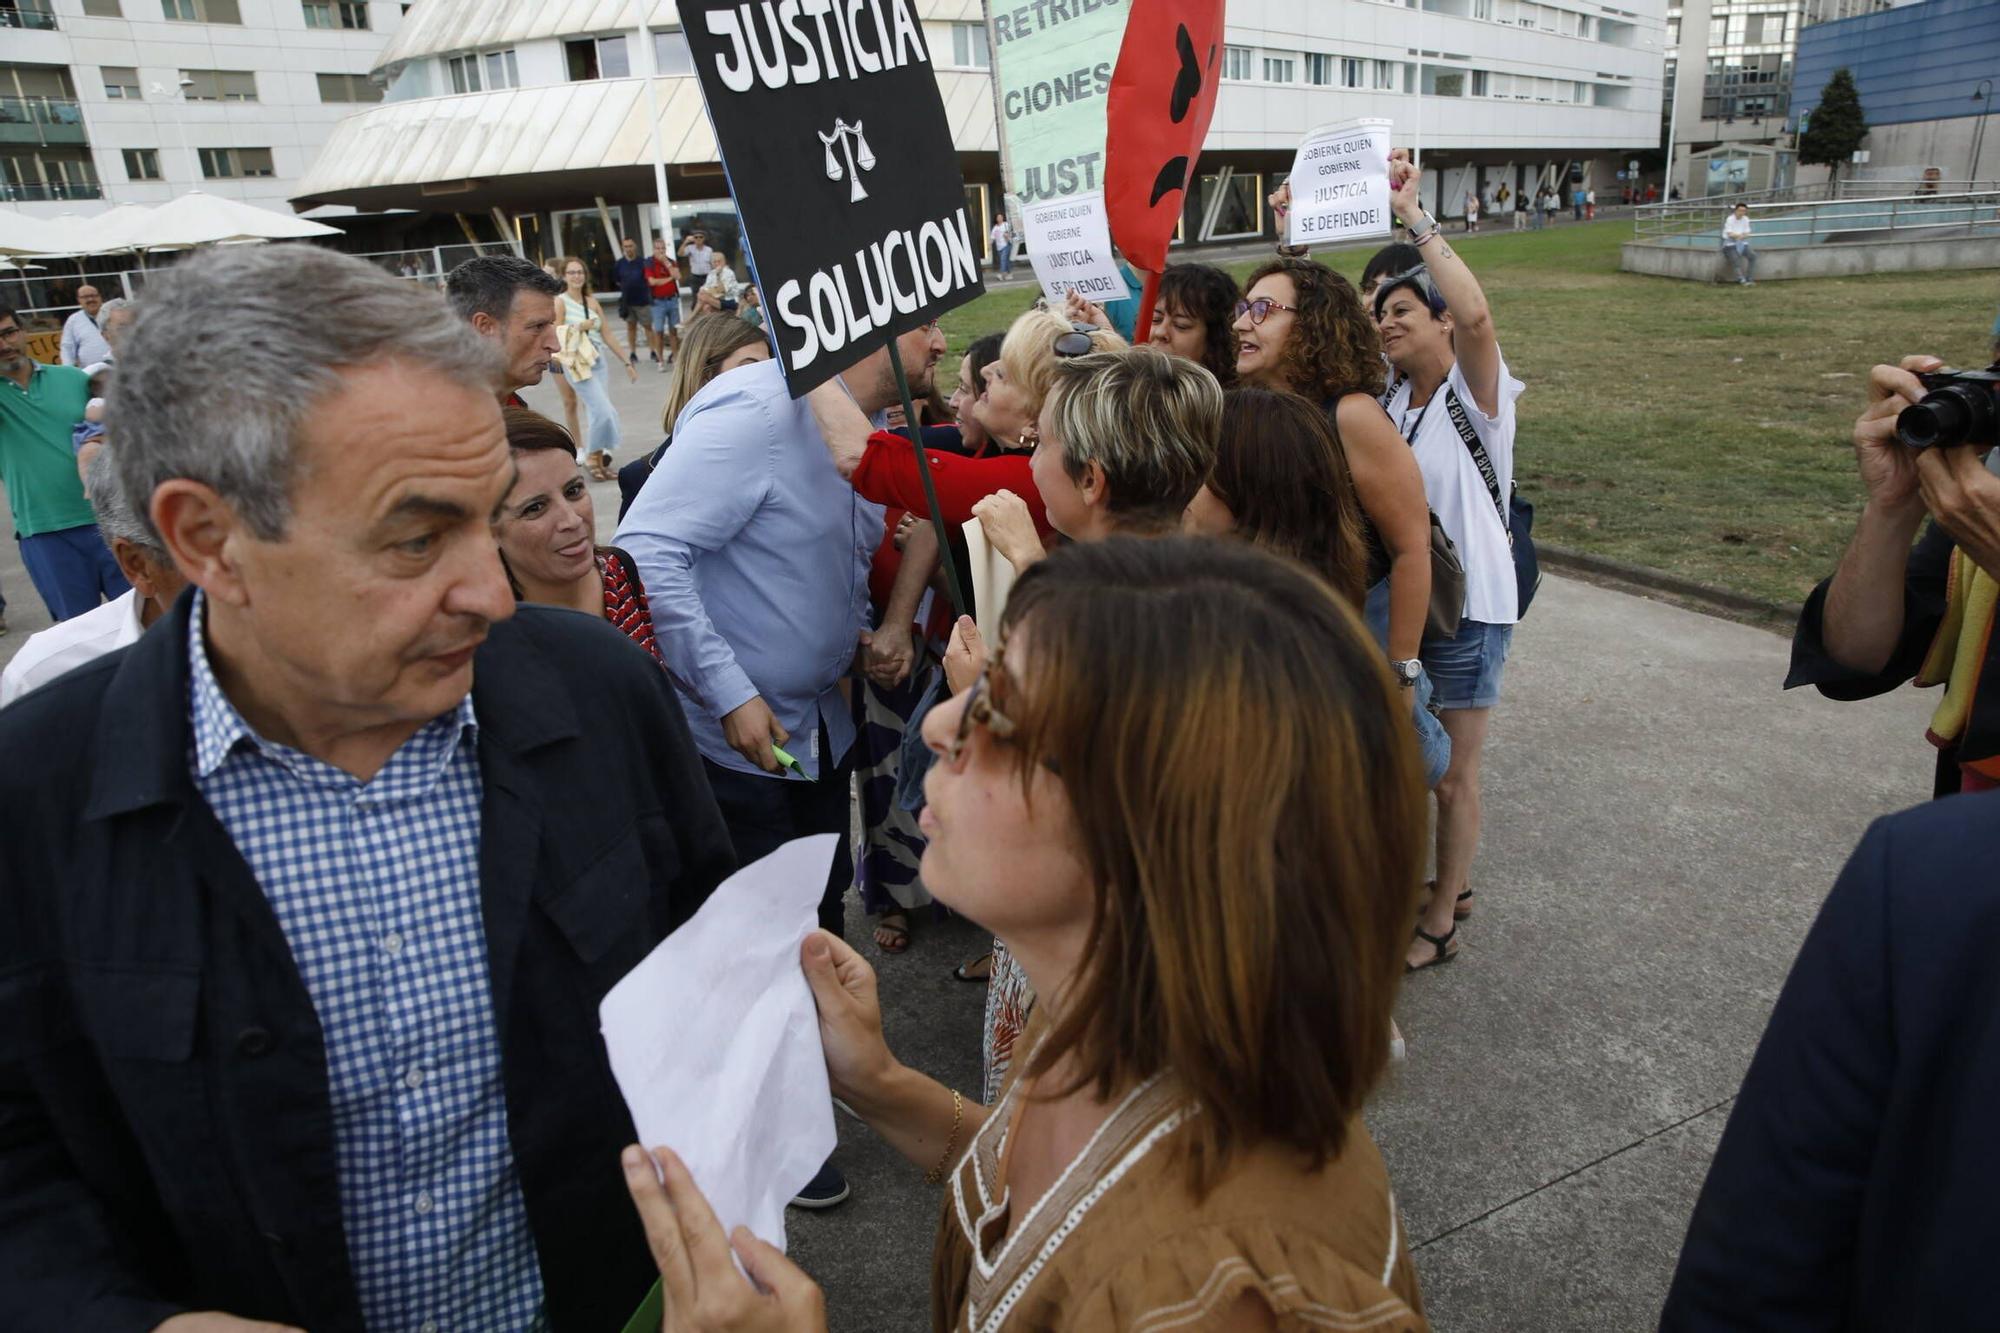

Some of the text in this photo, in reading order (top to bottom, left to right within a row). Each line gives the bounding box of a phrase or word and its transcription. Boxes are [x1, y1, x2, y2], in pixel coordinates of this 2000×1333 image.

[993, 0, 1119, 46] RETRI
[705, 0, 927, 92] JUSTICIA
[1004, 62, 1112, 120] CIONES
[1343, 138, 1372, 154] QUIEN
[1318, 160, 1361, 176] GOBIERNE
[1315, 181, 1368, 204] ¡JUSTICIA
[1035, 205, 1092, 224] GOBIERNE QUIEN
[1302, 208, 1380, 232] SE DEFIENDE!
[1047, 226, 1082, 242] GOBIERNE
[1047, 249, 1095, 269] ¡JUSTICIA
[776, 208, 978, 370] SOLUCION
[1051, 280, 1063, 295] SE
[1446, 396, 1475, 442] BIMBA
[1473, 446, 1498, 490] BIMBA
